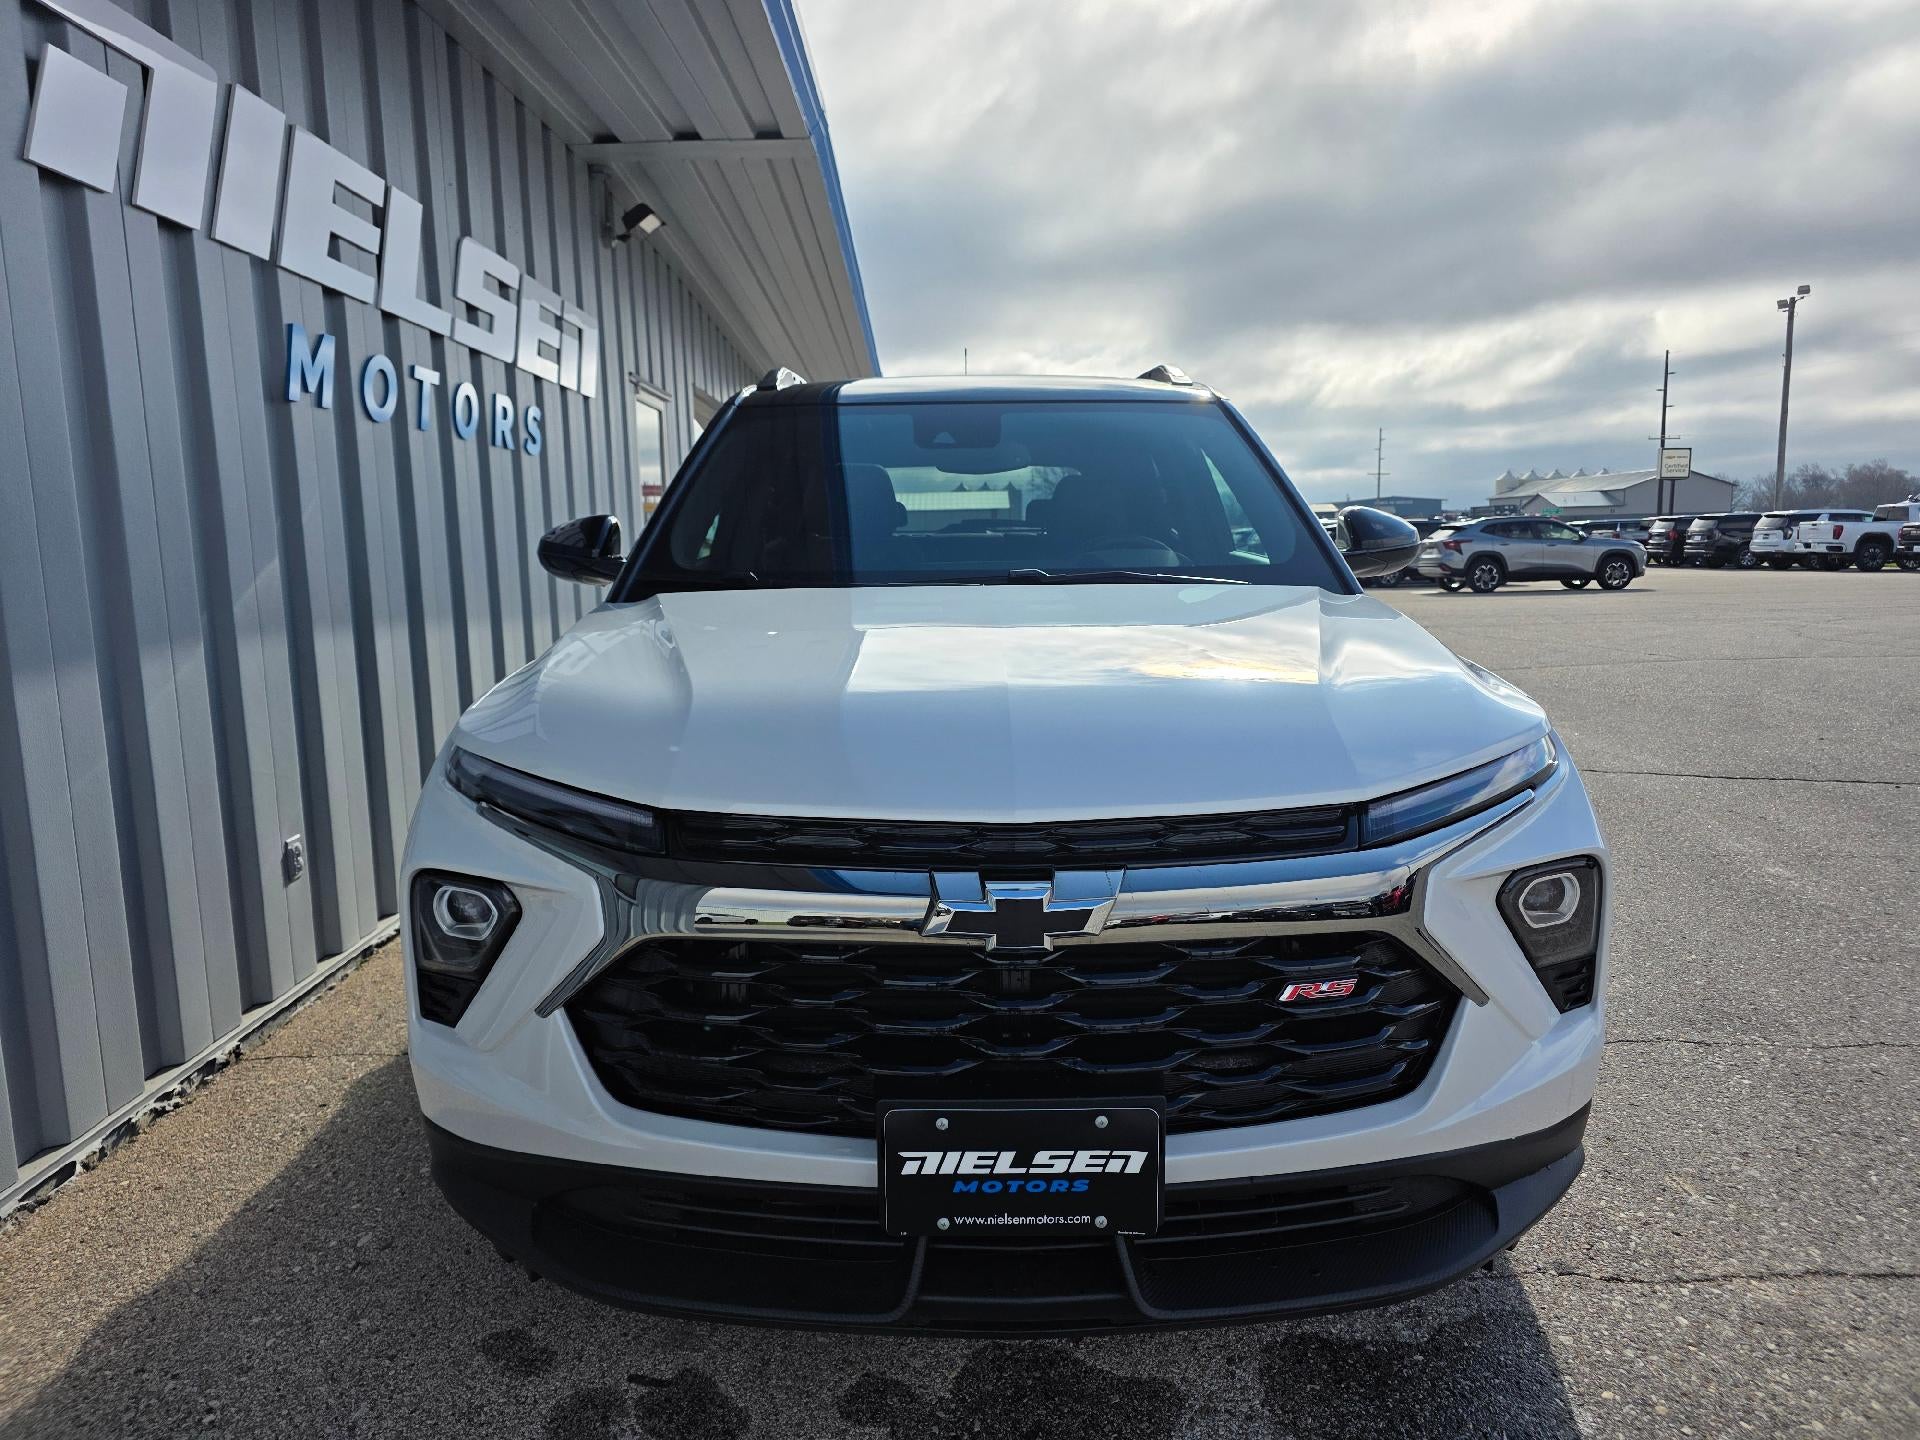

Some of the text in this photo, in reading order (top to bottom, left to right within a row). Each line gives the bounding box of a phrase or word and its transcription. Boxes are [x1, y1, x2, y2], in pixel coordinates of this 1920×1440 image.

[287, 323, 542, 456] MOTORS
[1279, 979, 1358, 1001] RS
[898, 1150, 1149, 1175] NIELSEN
[952, 1179, 1090, 1193] MOTORS
[953, 1213, 1091, 1225] www.nielsenmotors.com
